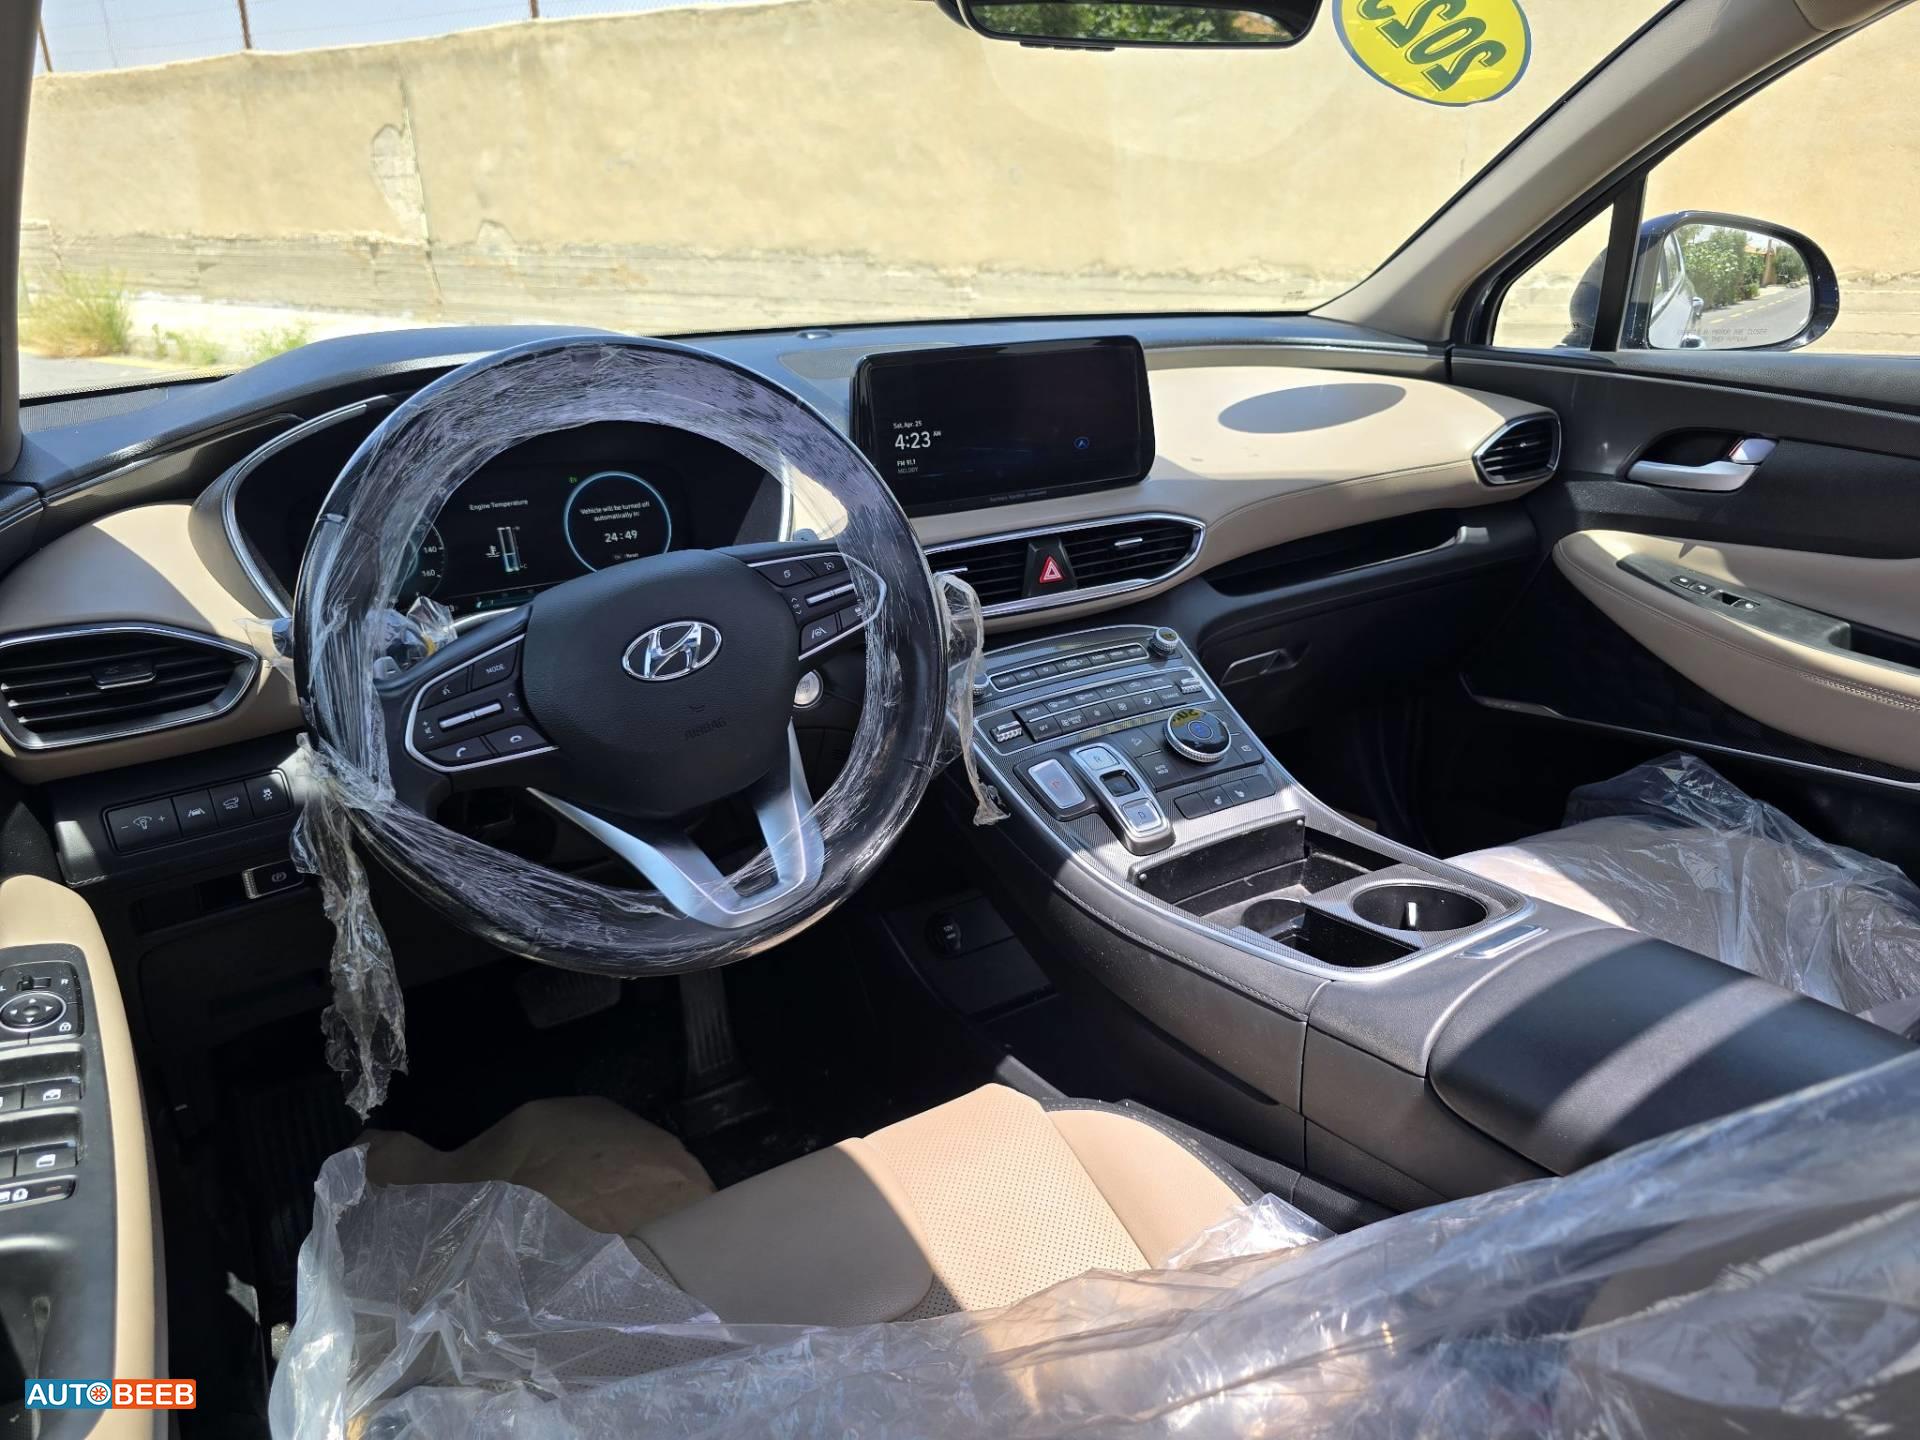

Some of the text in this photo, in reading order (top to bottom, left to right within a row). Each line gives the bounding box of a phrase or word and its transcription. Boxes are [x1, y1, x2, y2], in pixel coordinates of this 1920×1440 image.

[895, 431, 931, 450] 4:23
[469, 499, 529, 511] Engine Temperature
[622, 502, 641, 510] turned
[486, 663, 505, 674] MODE
